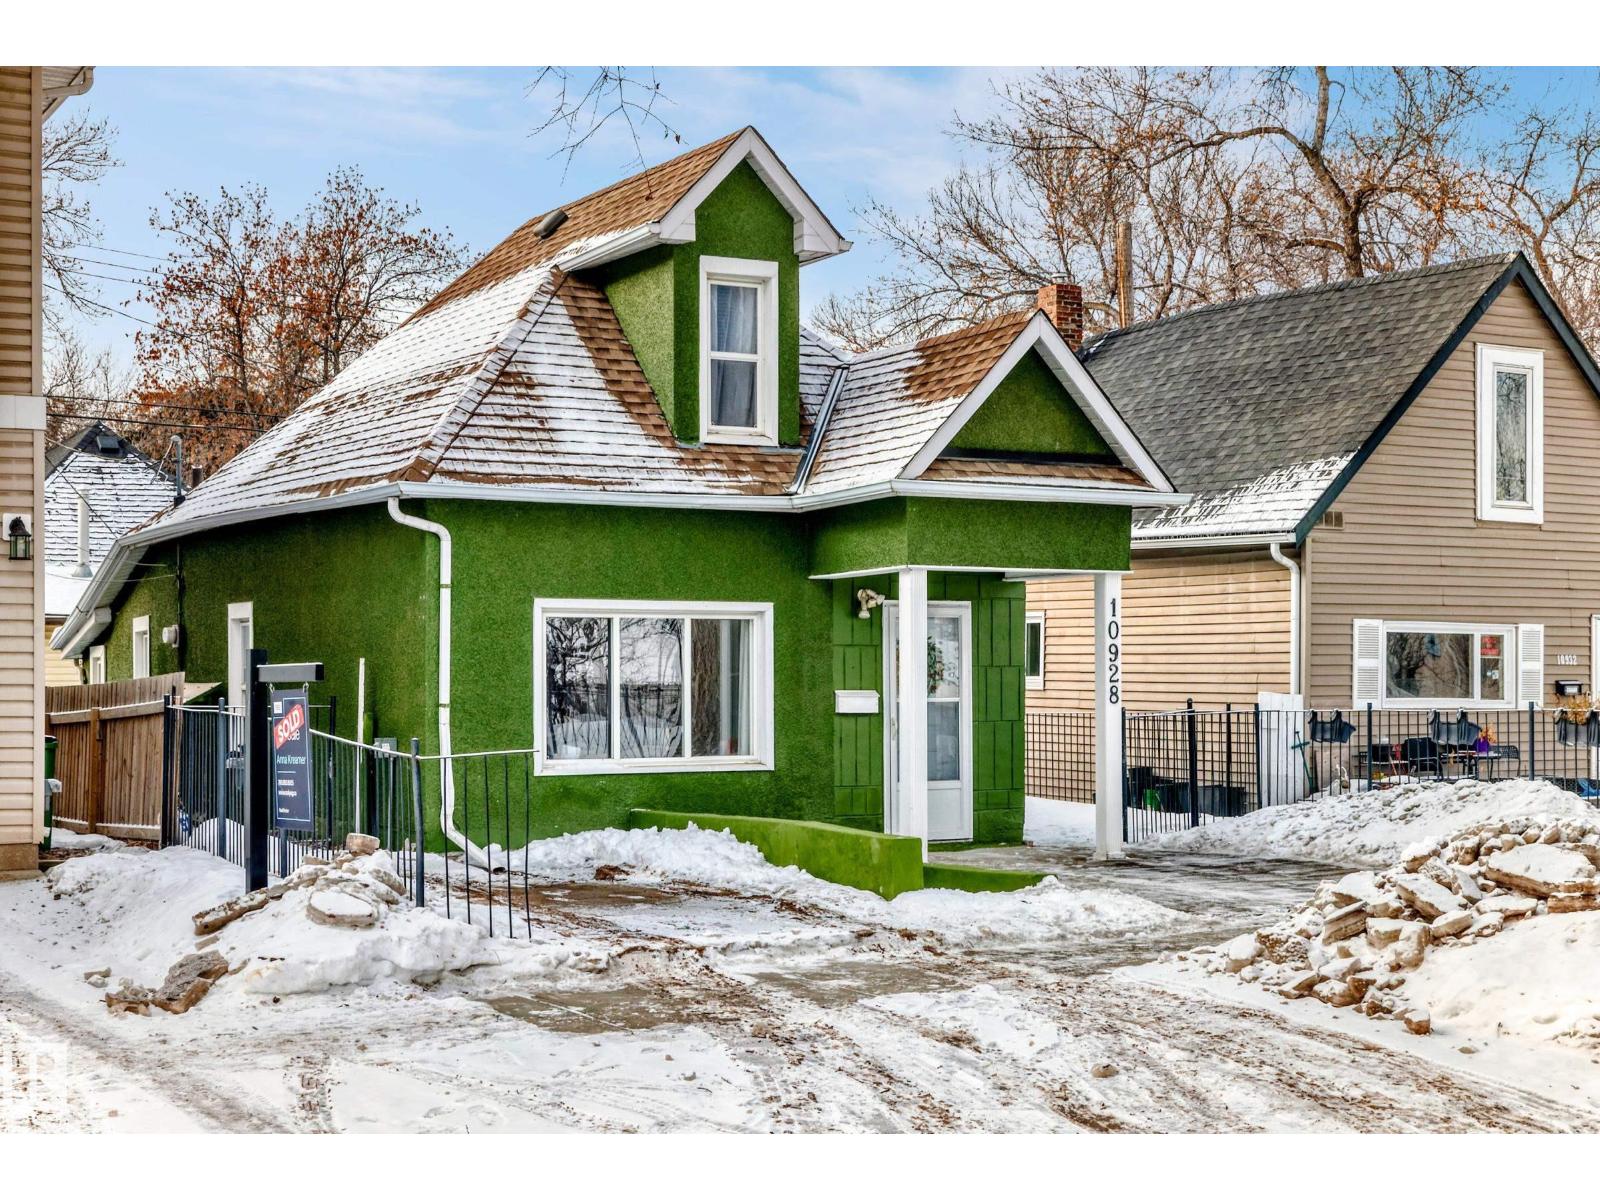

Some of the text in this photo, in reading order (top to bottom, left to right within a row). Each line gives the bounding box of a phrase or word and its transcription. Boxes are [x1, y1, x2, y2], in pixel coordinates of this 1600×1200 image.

[1108, 598, 1119, 704] 10928
[278, 709, 300, 743] SOLD
[276, 754, 288, 764] Anna
